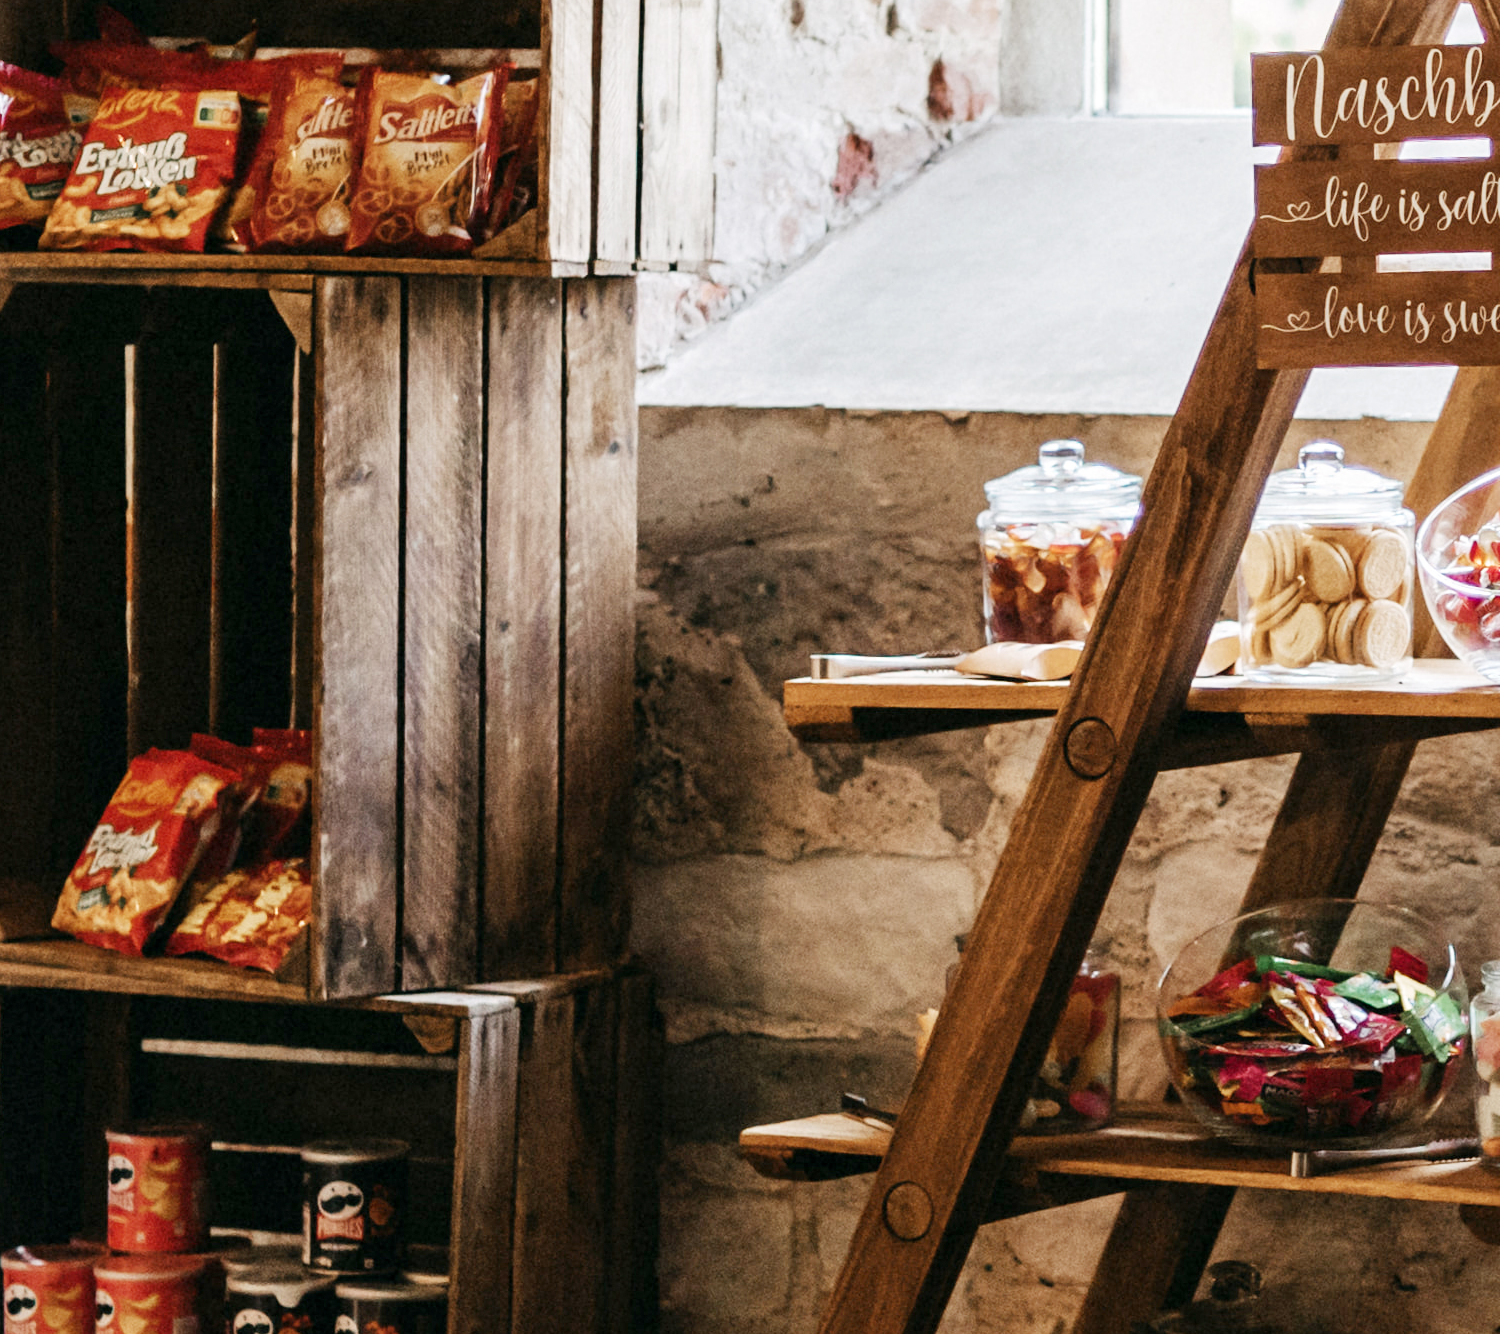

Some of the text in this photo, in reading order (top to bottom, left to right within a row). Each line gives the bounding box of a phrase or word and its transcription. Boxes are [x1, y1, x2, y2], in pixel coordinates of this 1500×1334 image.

[1324, 175, 1391, 242] life
[1399, 188, 1430, 232] is
[1323, 285, 1395, 339] love
[1404, 300, 1436, 343] is
